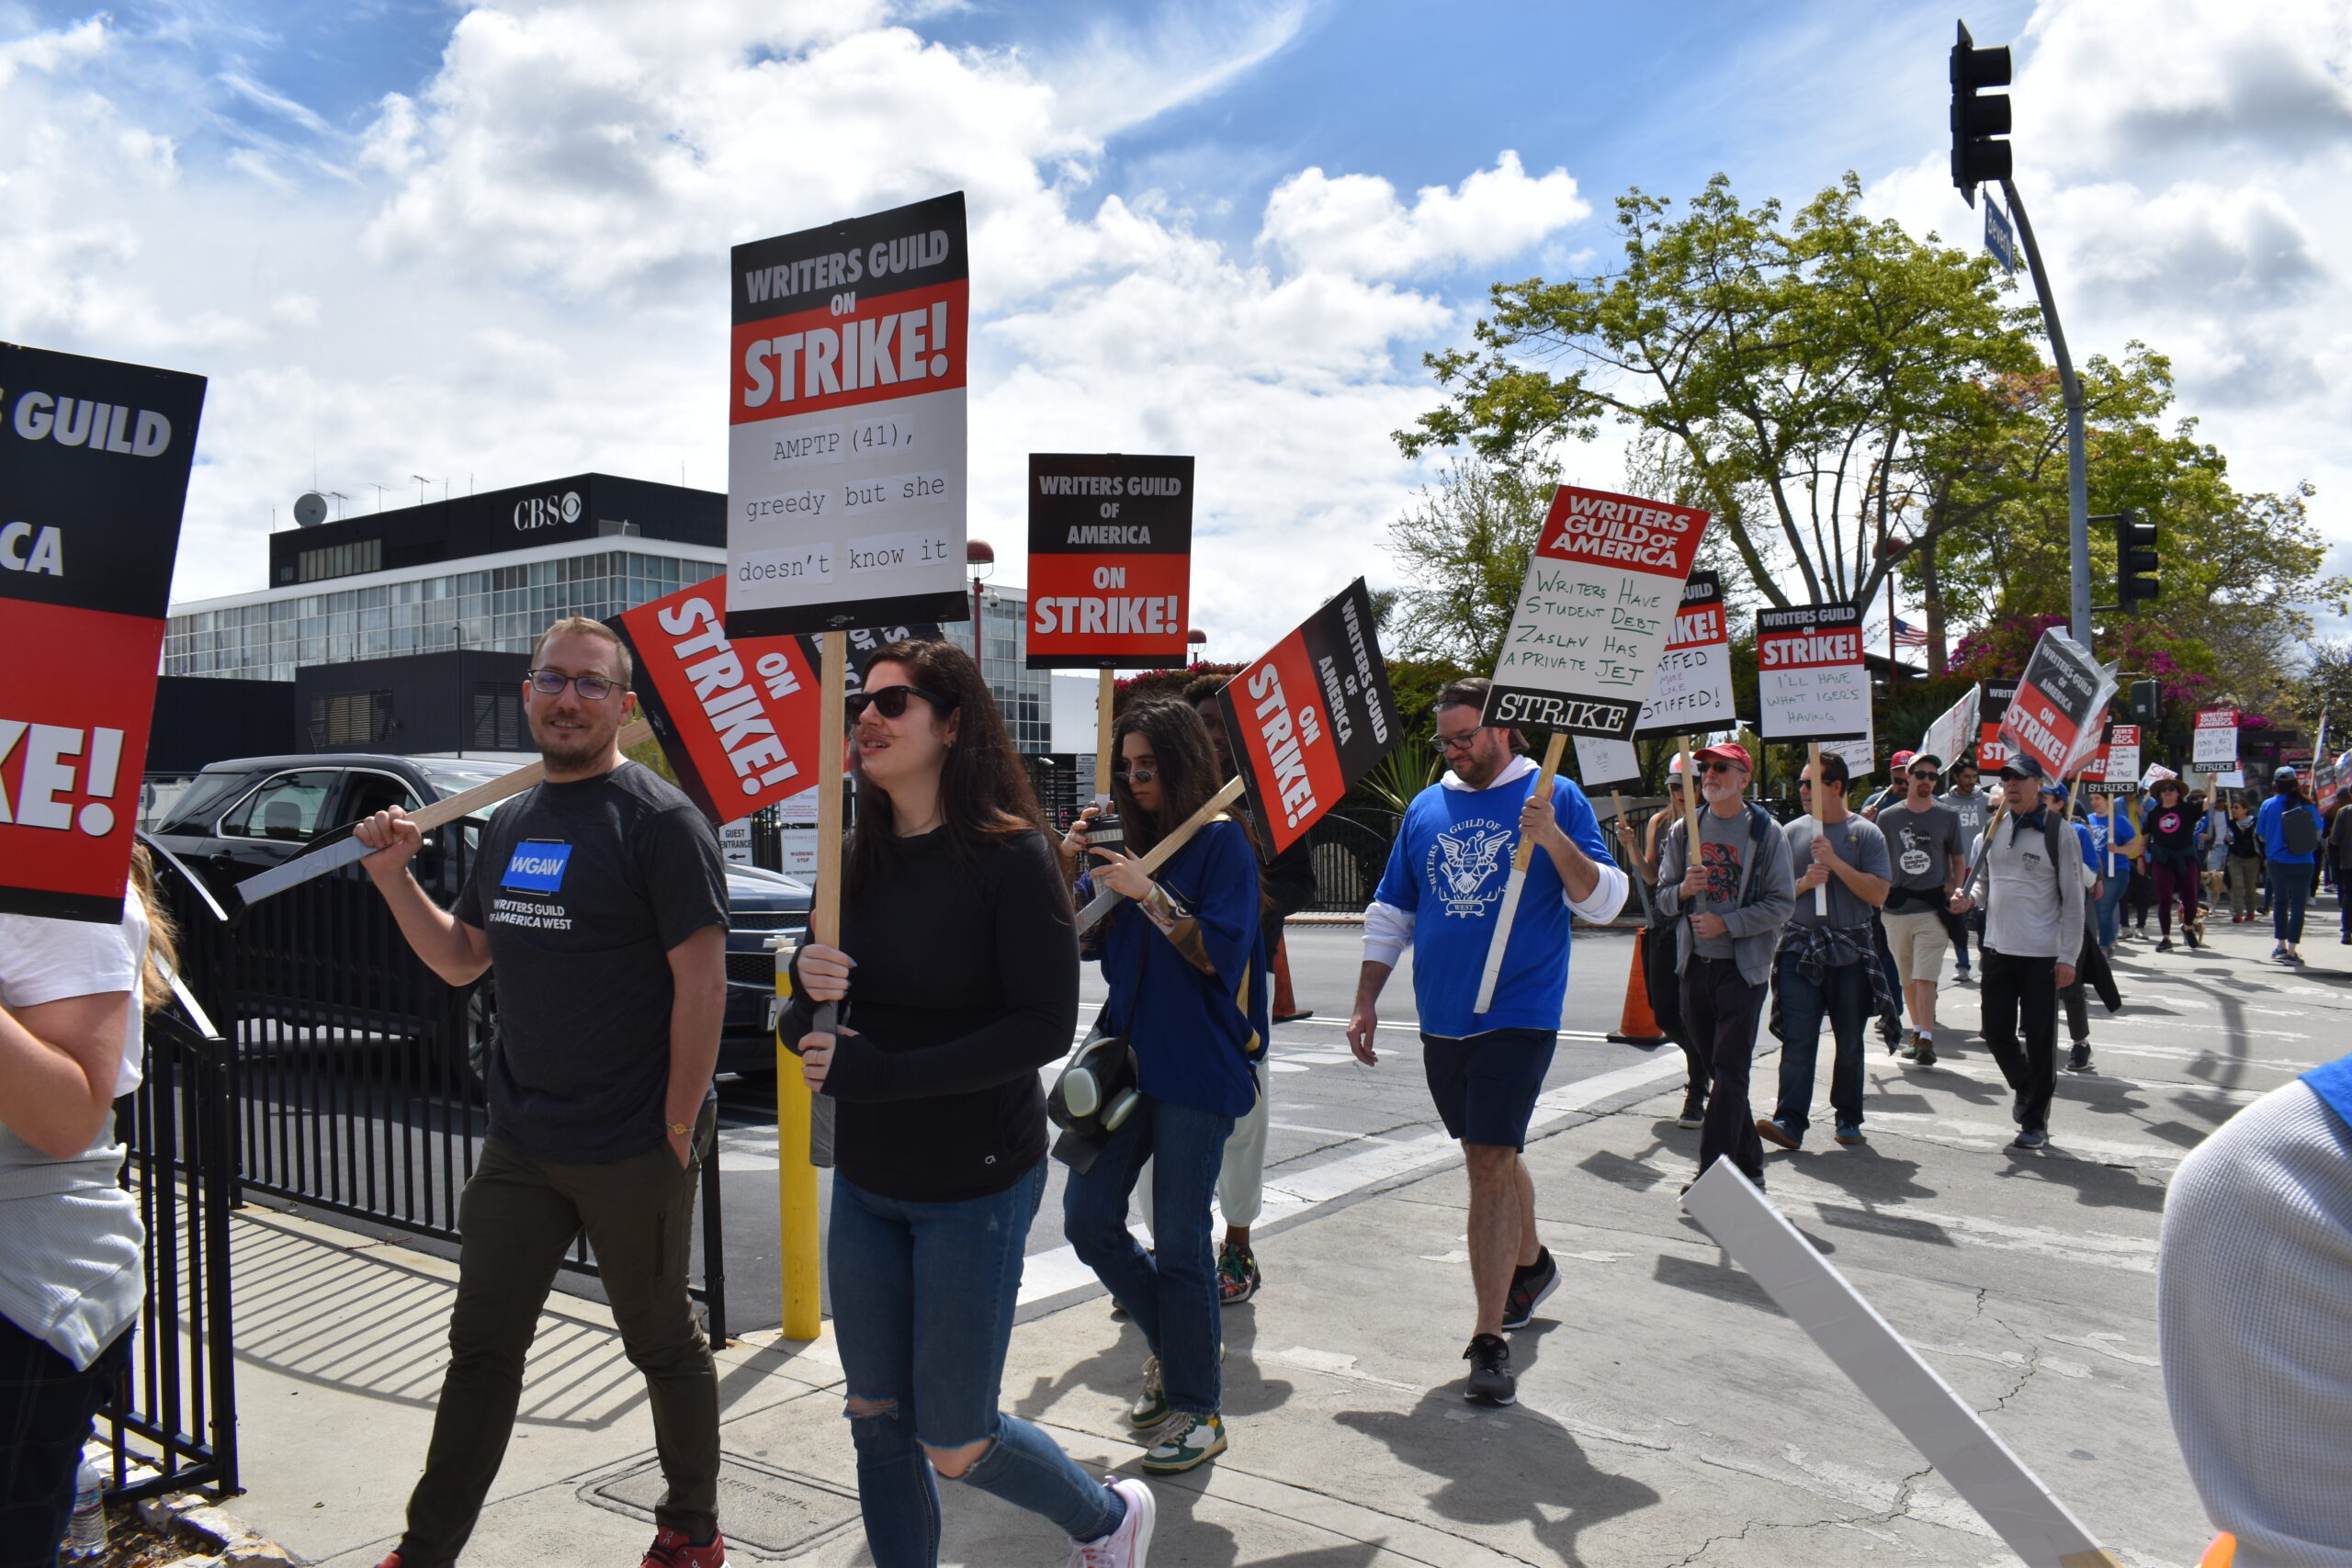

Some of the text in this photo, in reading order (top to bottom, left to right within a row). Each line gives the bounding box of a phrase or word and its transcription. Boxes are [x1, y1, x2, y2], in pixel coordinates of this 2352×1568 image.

[1988, 208, 2012, 265] Beverly
[745, 230, 949, 303] WRITERS GUILD
[831, 291, 856, 316] ON
[744, 301, 948, 408] STRIKE!
[14, 391, 172, 457] GUILD
[774, 423, 913, 461] AMPTP (41),
[746, 477, 944, 522] greedy but she
[1039, 476, 1182, 496] WRITERS GUILD
[514, 495, 560, 531] CBS
[1100, 502, 1120, 518] OF
[1570, 496, 1691, 533] WRITERS
[1067, 525, 1151, 544] AMERICA
[1565, 515, 1679, 549] GUILD OF
[739, 539, 948, 581] doesn't know it
[1550, 533, 1678, 569] AMERICA
[1092, 567, 1125, 589] ON
[1035, 595, 1179, 635] STRIKE!
[1762, 607, 1856, 626] WRITERS GUILD
[1803, 626, 1815, 636] ON
[1764, 634, 1858, 666] STRIKE!
[756, 652, 801, 700] ON
[1341, 597, 1388, 745] WRITERS GUILD
[1344, 674, 1358, 696] OF
[1818, 672, 1852, 684] HAVE
[2041, 644, 2093, 697] WRITERS GUILD
[2057, 677, 2068, 688] OF
[658, 597, 799, 796] STRIKE!
[1318, 655, 1353, 746] AMERICA
[1767, 694, 1806, 707] WHAT
[2040, 678, 2073, 713] AMERICA
[1298, 705, 1321, 747] ON
[1496, 694, 1628, 732] STRIKE
[1787, 711, 1836, 724] HAVING
[2040, 707, 2055, 727] ON
[1248, 663, 1317, 829] STRIKE!
[2008, 704, 2067, 767] STRIKE!
[2195, 762, 2233, 772] STRIKE
[2088, 784, 2134, 792] STRIKE
[725, 829, 745, 838] GUEST
[1450, 818, 1502, 834] GUILD OF
[719, 840, 752, 849] ENTRANCE
[511, 857, 564, 875] WGAW
[493, 899, 565, 917] WRITERS GUILD
[494, 912, 542, 928] AMERICA
[543, 919, 572, 930] WEST
